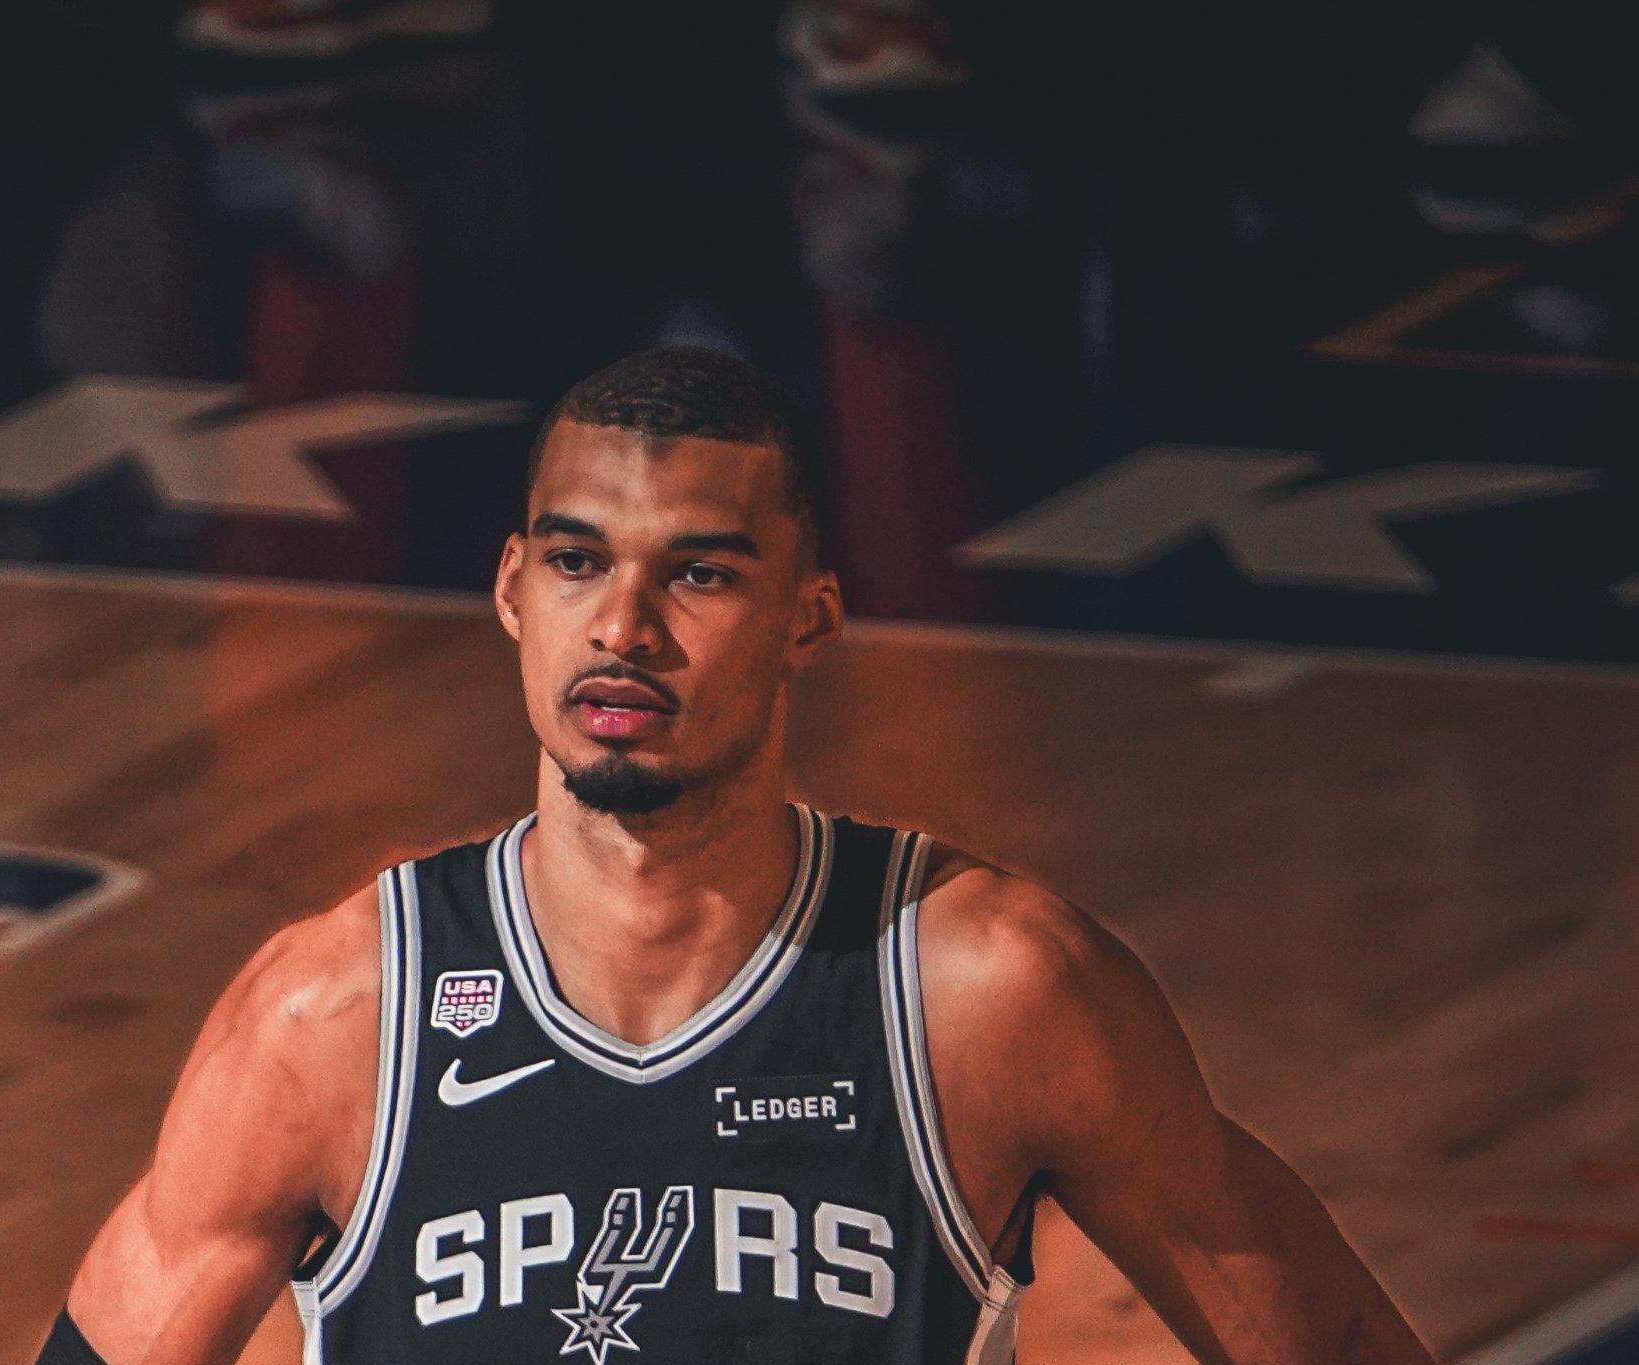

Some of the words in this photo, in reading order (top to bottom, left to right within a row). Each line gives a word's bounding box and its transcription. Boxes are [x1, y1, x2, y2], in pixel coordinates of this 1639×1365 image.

[444, 979, 493, 996] USA
[437, 1003, 494, 1021] 250
[733, 1095, 838, 1122] LEDGER
